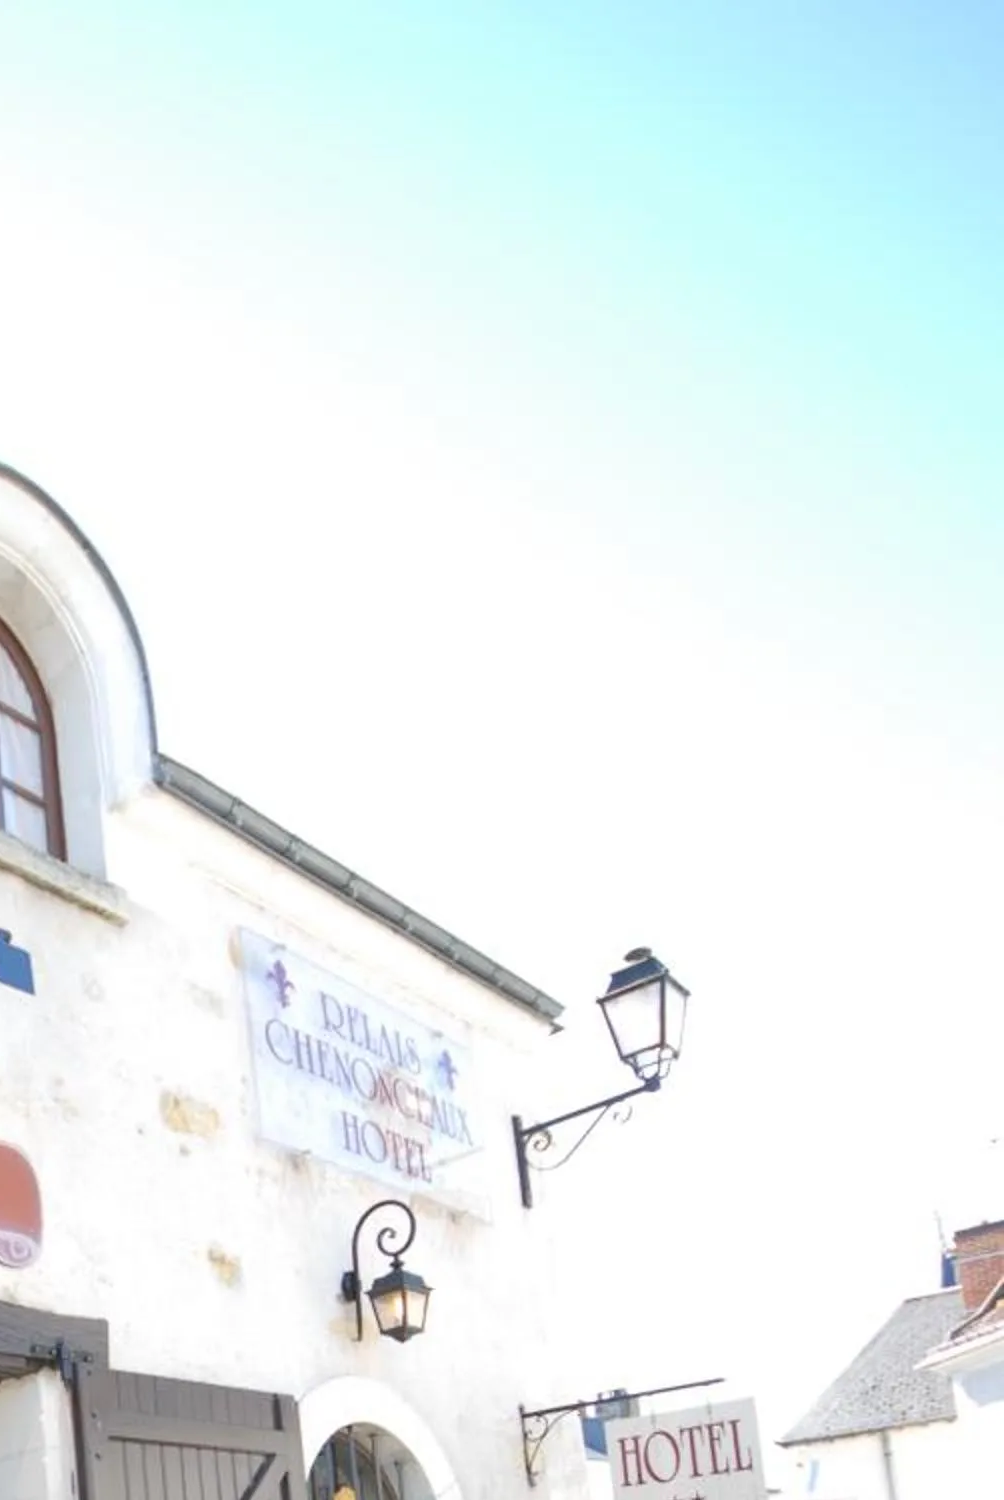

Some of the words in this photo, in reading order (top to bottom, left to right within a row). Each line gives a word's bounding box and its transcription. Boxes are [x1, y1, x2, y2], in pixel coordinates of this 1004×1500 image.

[321, 991, 421, 1075] RELAIS
[265, 1018, 474, 1147] CHENONCEAUX
[341, 1110, 433, 1184] HOTEL
[617, 1419, 753, 1487] HOTEL
